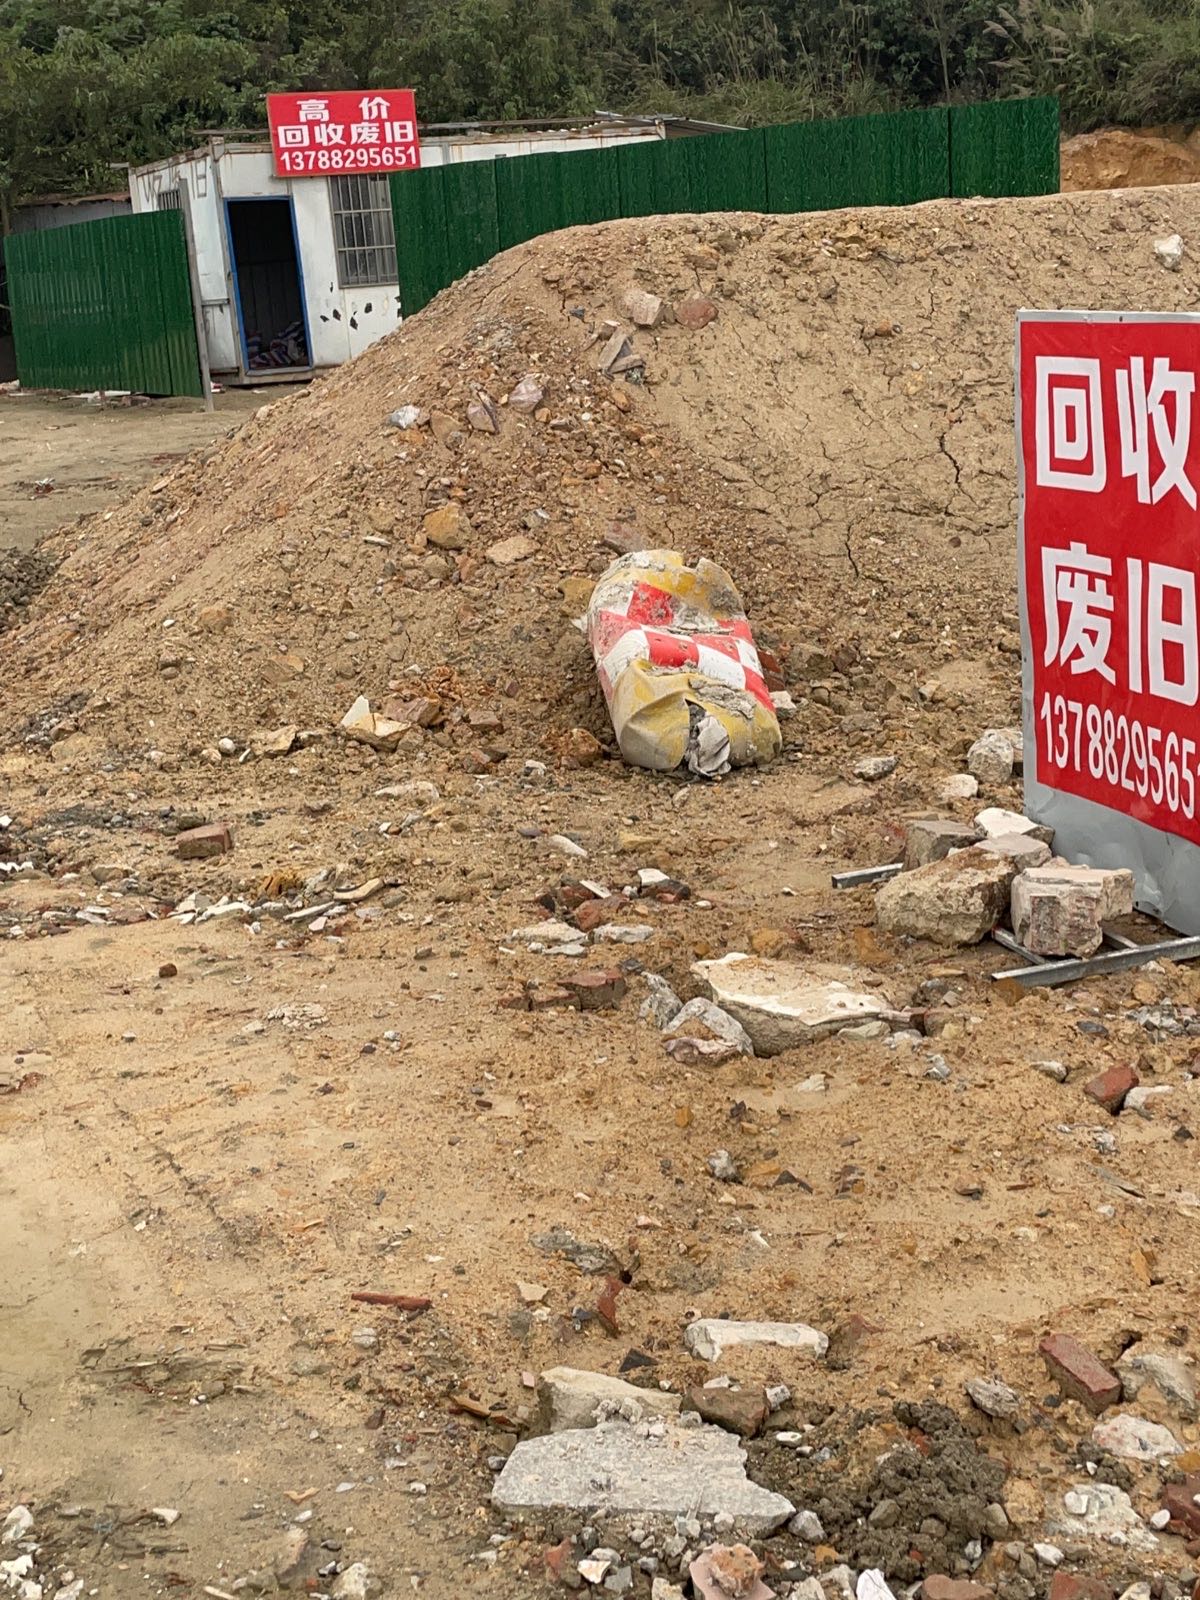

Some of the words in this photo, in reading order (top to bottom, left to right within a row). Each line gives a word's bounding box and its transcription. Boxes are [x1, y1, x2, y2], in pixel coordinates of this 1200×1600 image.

[277, 121, 414, 148] 回收废旧
[280, 146, 416, 171] 13788295651
[1035, 355, 1197, 511] 回收
[1041, 541, 1199, 706] 废旧
[1040, 692, 1200, 819] 1378829565
